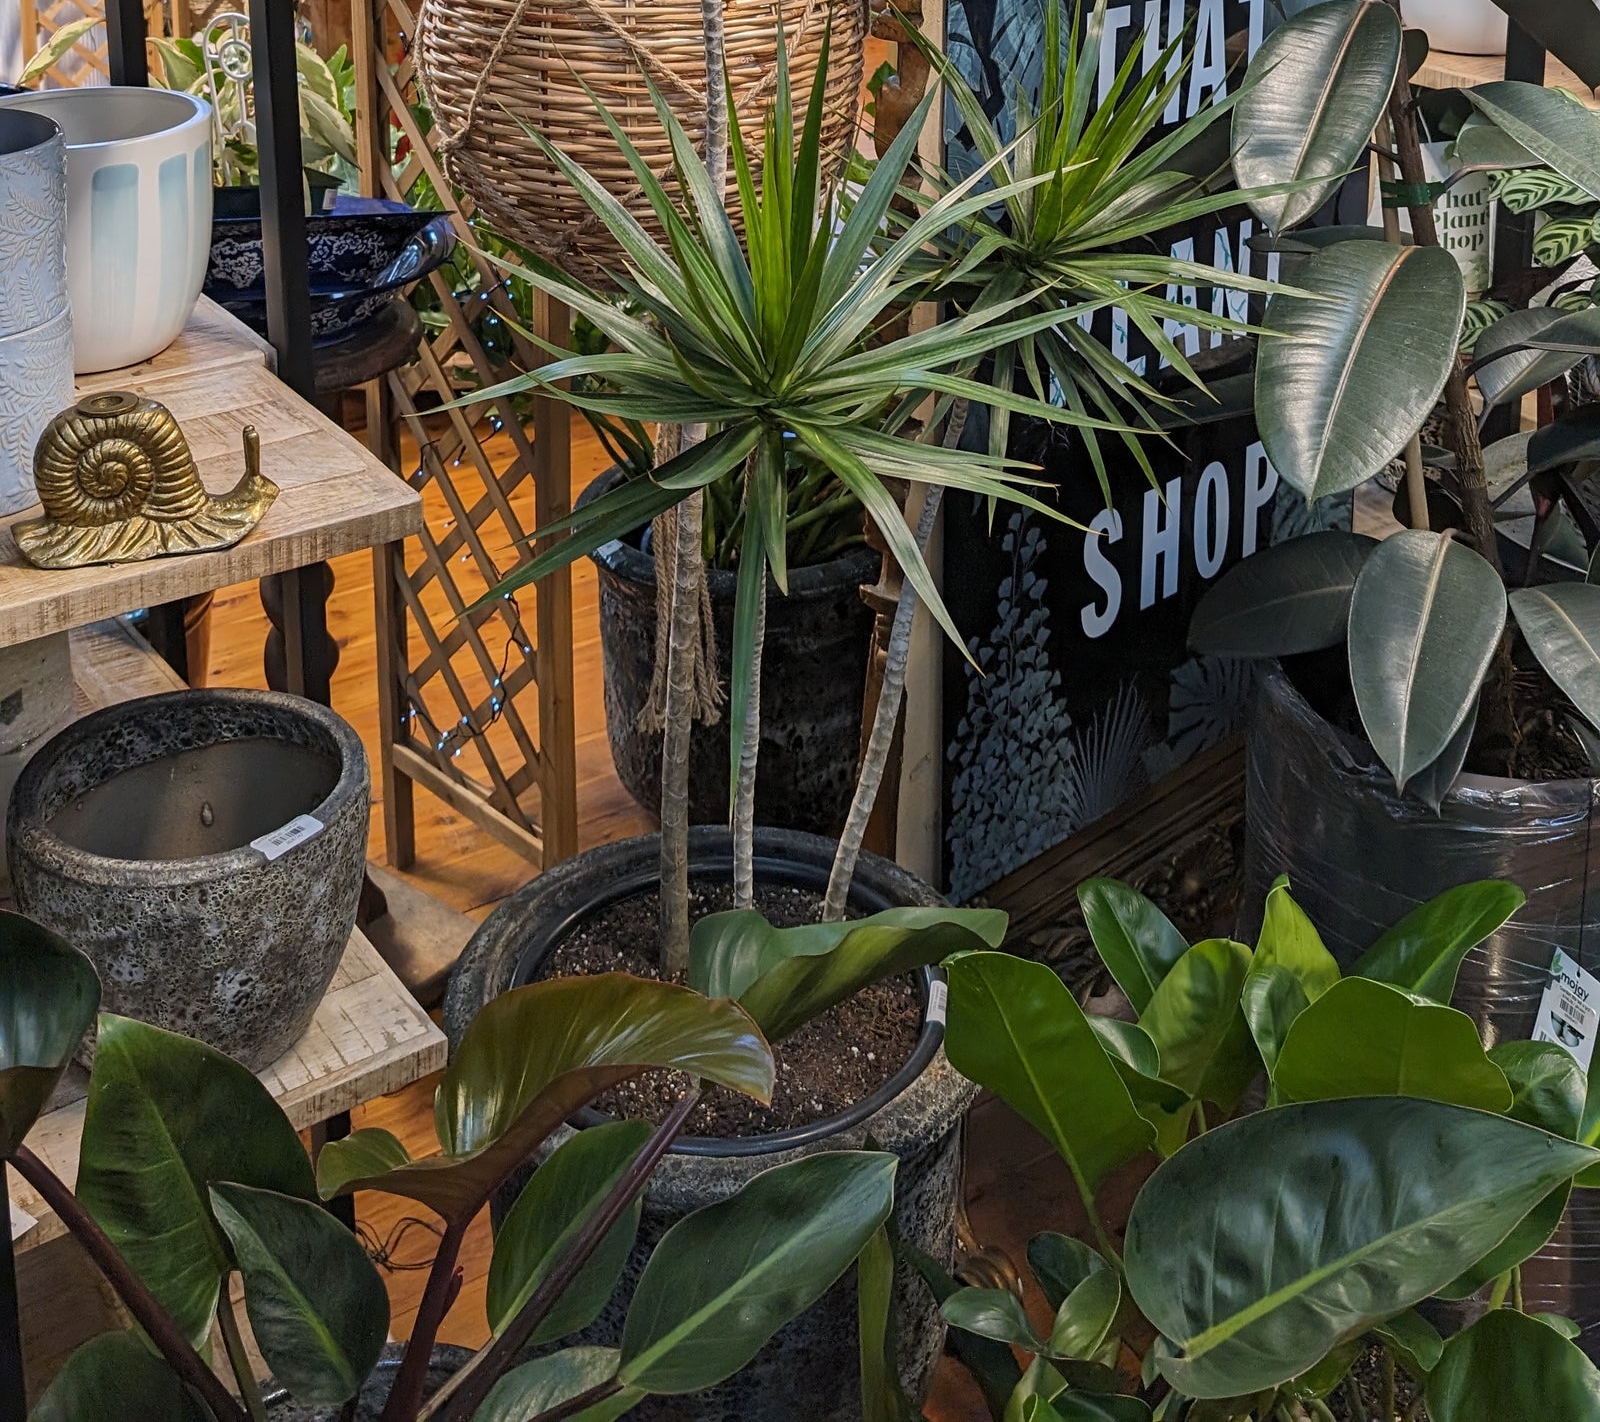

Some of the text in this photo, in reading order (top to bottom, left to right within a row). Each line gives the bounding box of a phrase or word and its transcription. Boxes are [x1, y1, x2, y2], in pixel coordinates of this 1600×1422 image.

[1436, 189, 1482, 209] hat
[1437, 230, 1484, 251] hop
[1081, 441, 1279, 639] SHOP
